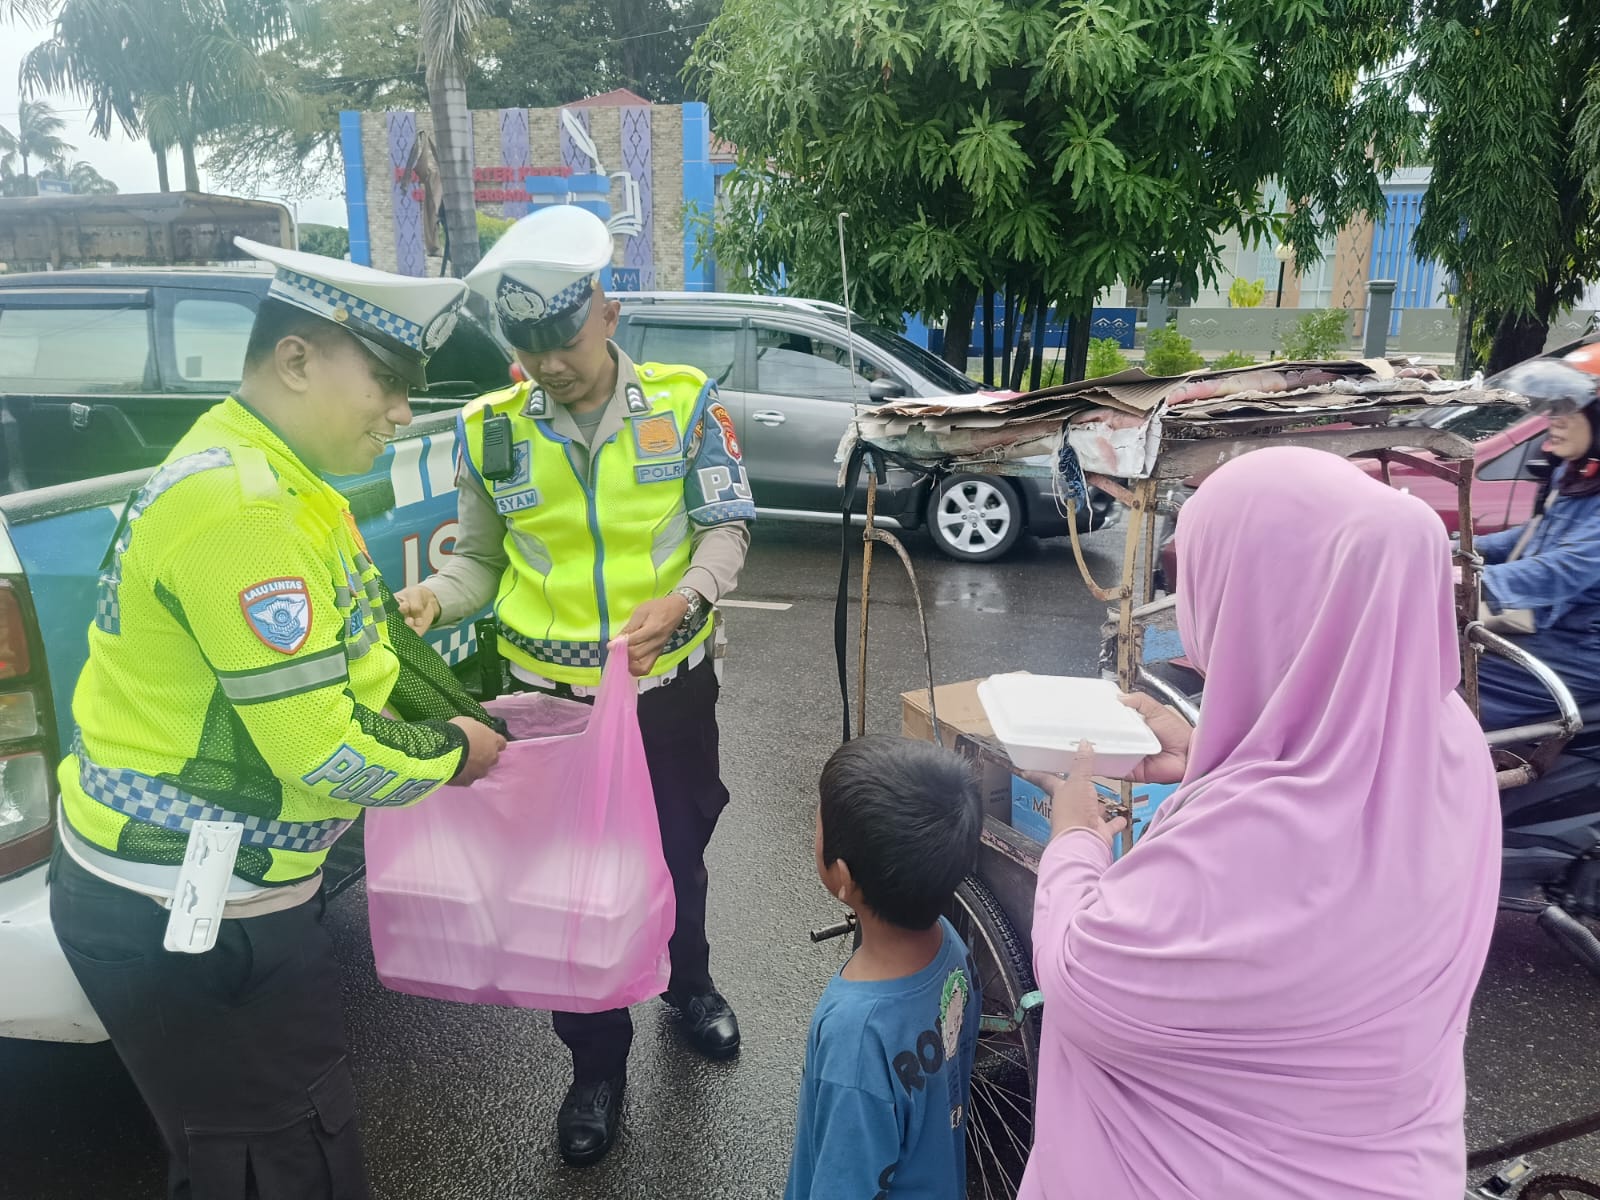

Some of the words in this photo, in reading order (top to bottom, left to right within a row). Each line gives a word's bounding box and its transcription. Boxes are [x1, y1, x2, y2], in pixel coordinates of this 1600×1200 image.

[244, 583, 271, 601] LALU
[269, 580, 303, 591] LINTAS
[892, 1015, 943, 1097] RO
